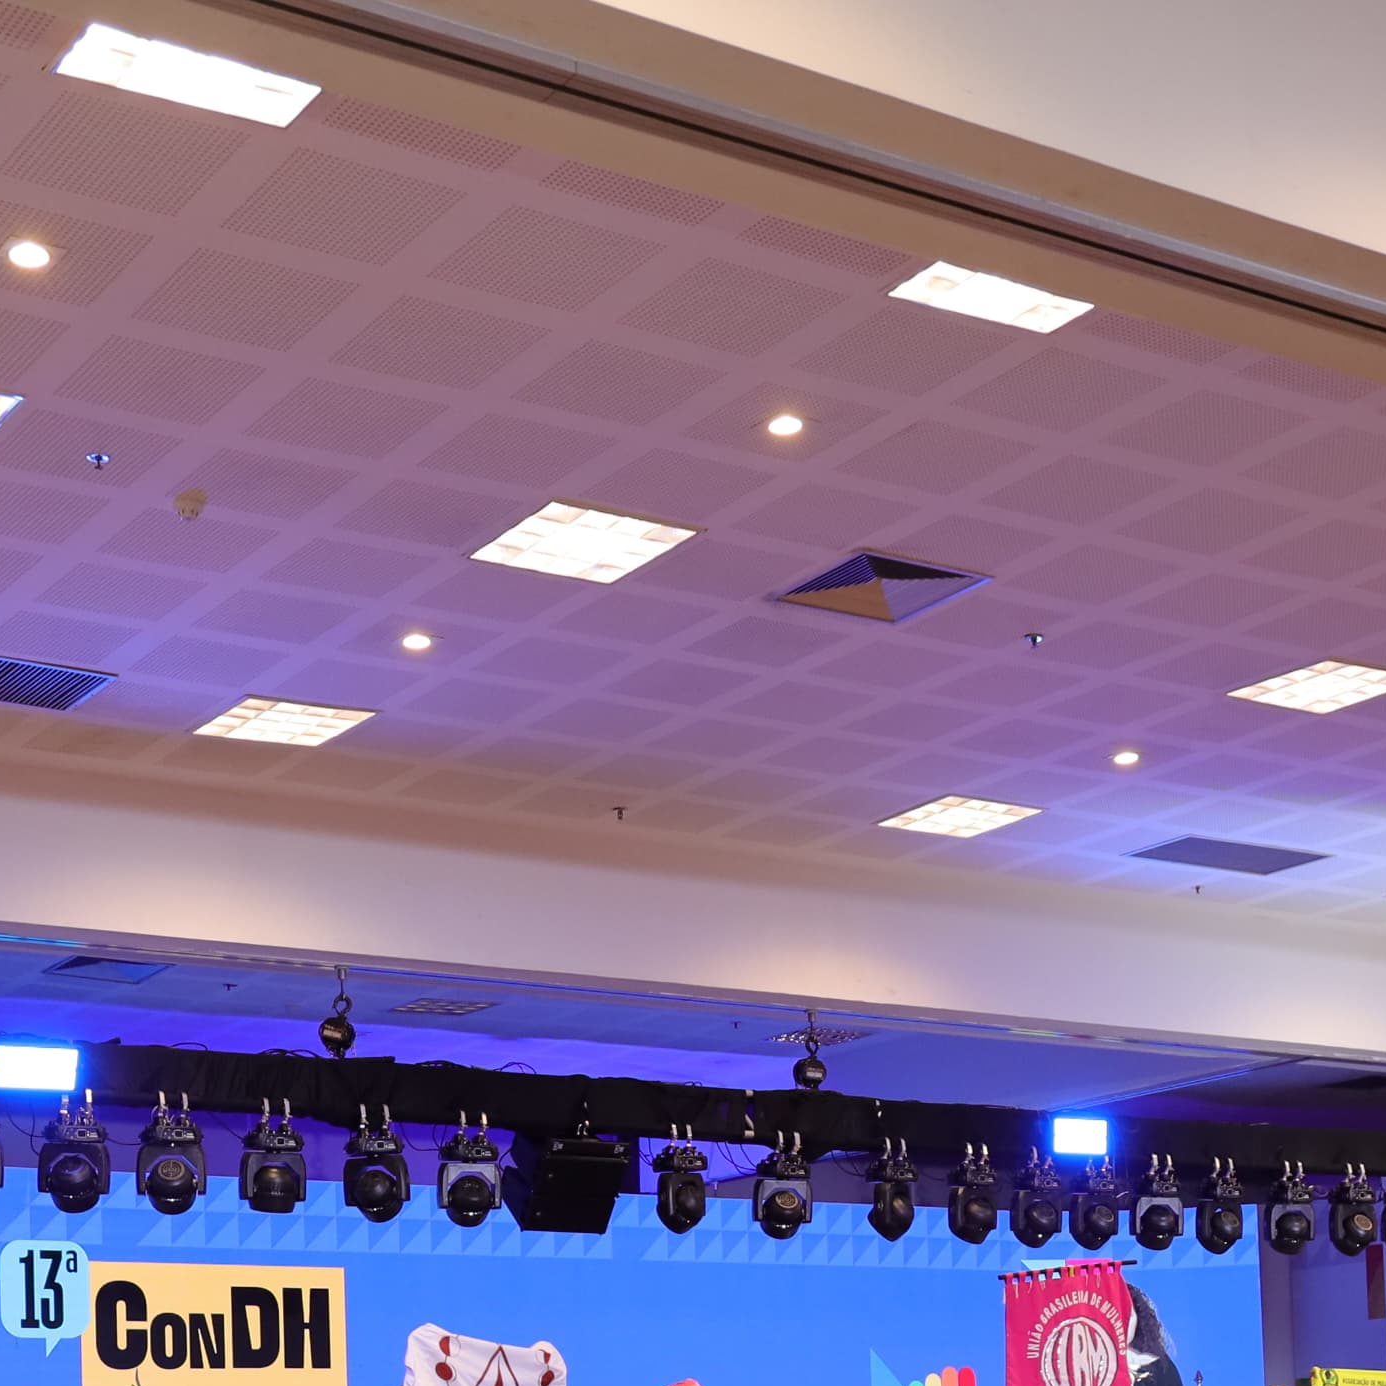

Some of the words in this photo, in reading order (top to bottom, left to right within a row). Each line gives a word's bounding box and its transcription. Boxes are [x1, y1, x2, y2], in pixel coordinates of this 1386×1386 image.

[19, 1249, 78, 1330] 13ª
[1026, 1324, 1047, 1360] UNIÃO
[1089, 1292, 1103, 1310] DE
